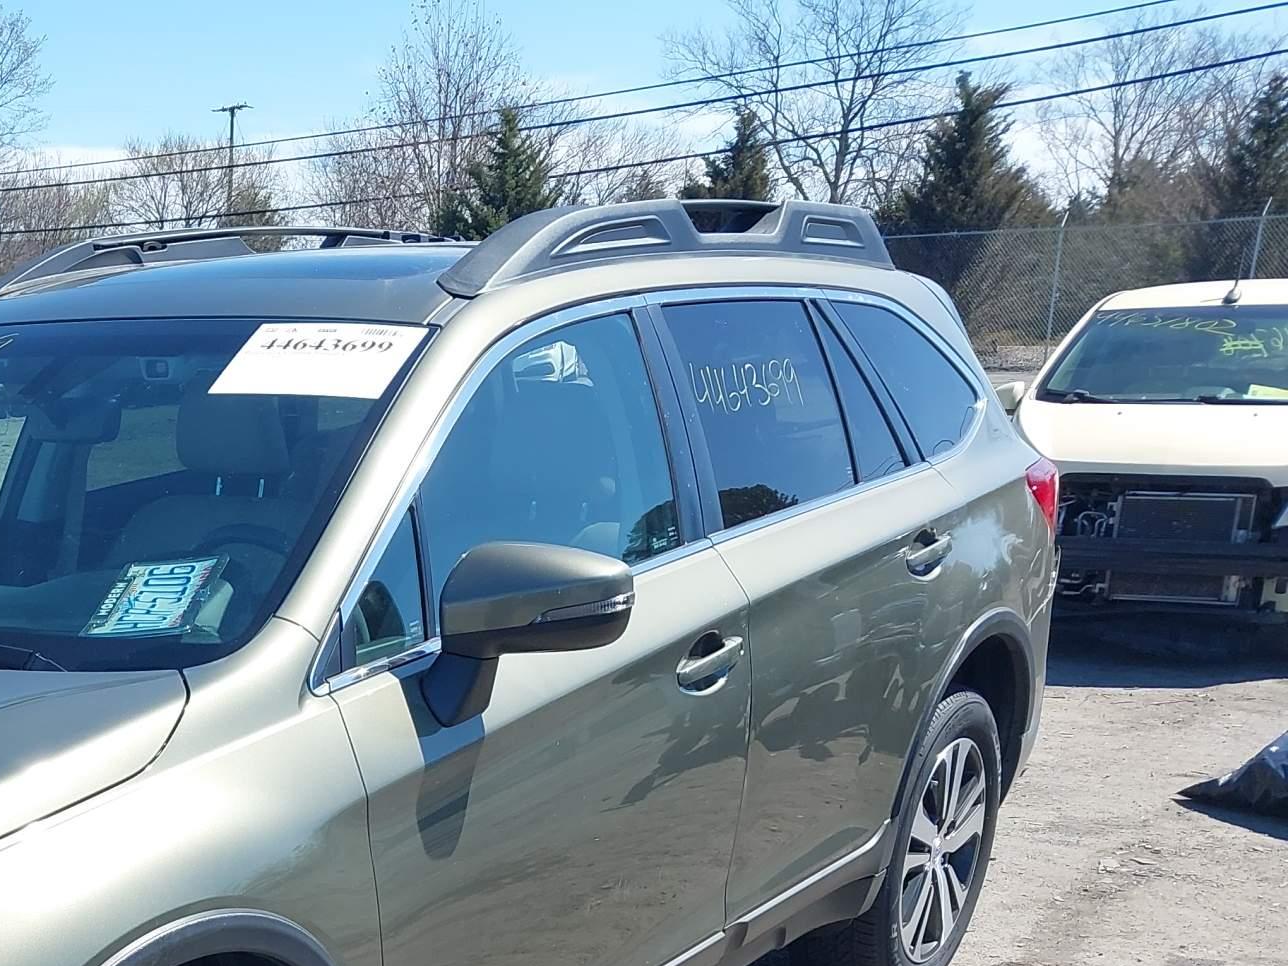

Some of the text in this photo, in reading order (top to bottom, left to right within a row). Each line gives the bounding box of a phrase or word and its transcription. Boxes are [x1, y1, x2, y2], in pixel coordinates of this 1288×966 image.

[260, 337, 394, 353] 44643699
[688, 358, 805, 415] 44643699
[96, 581, 129, 616] MODERN
